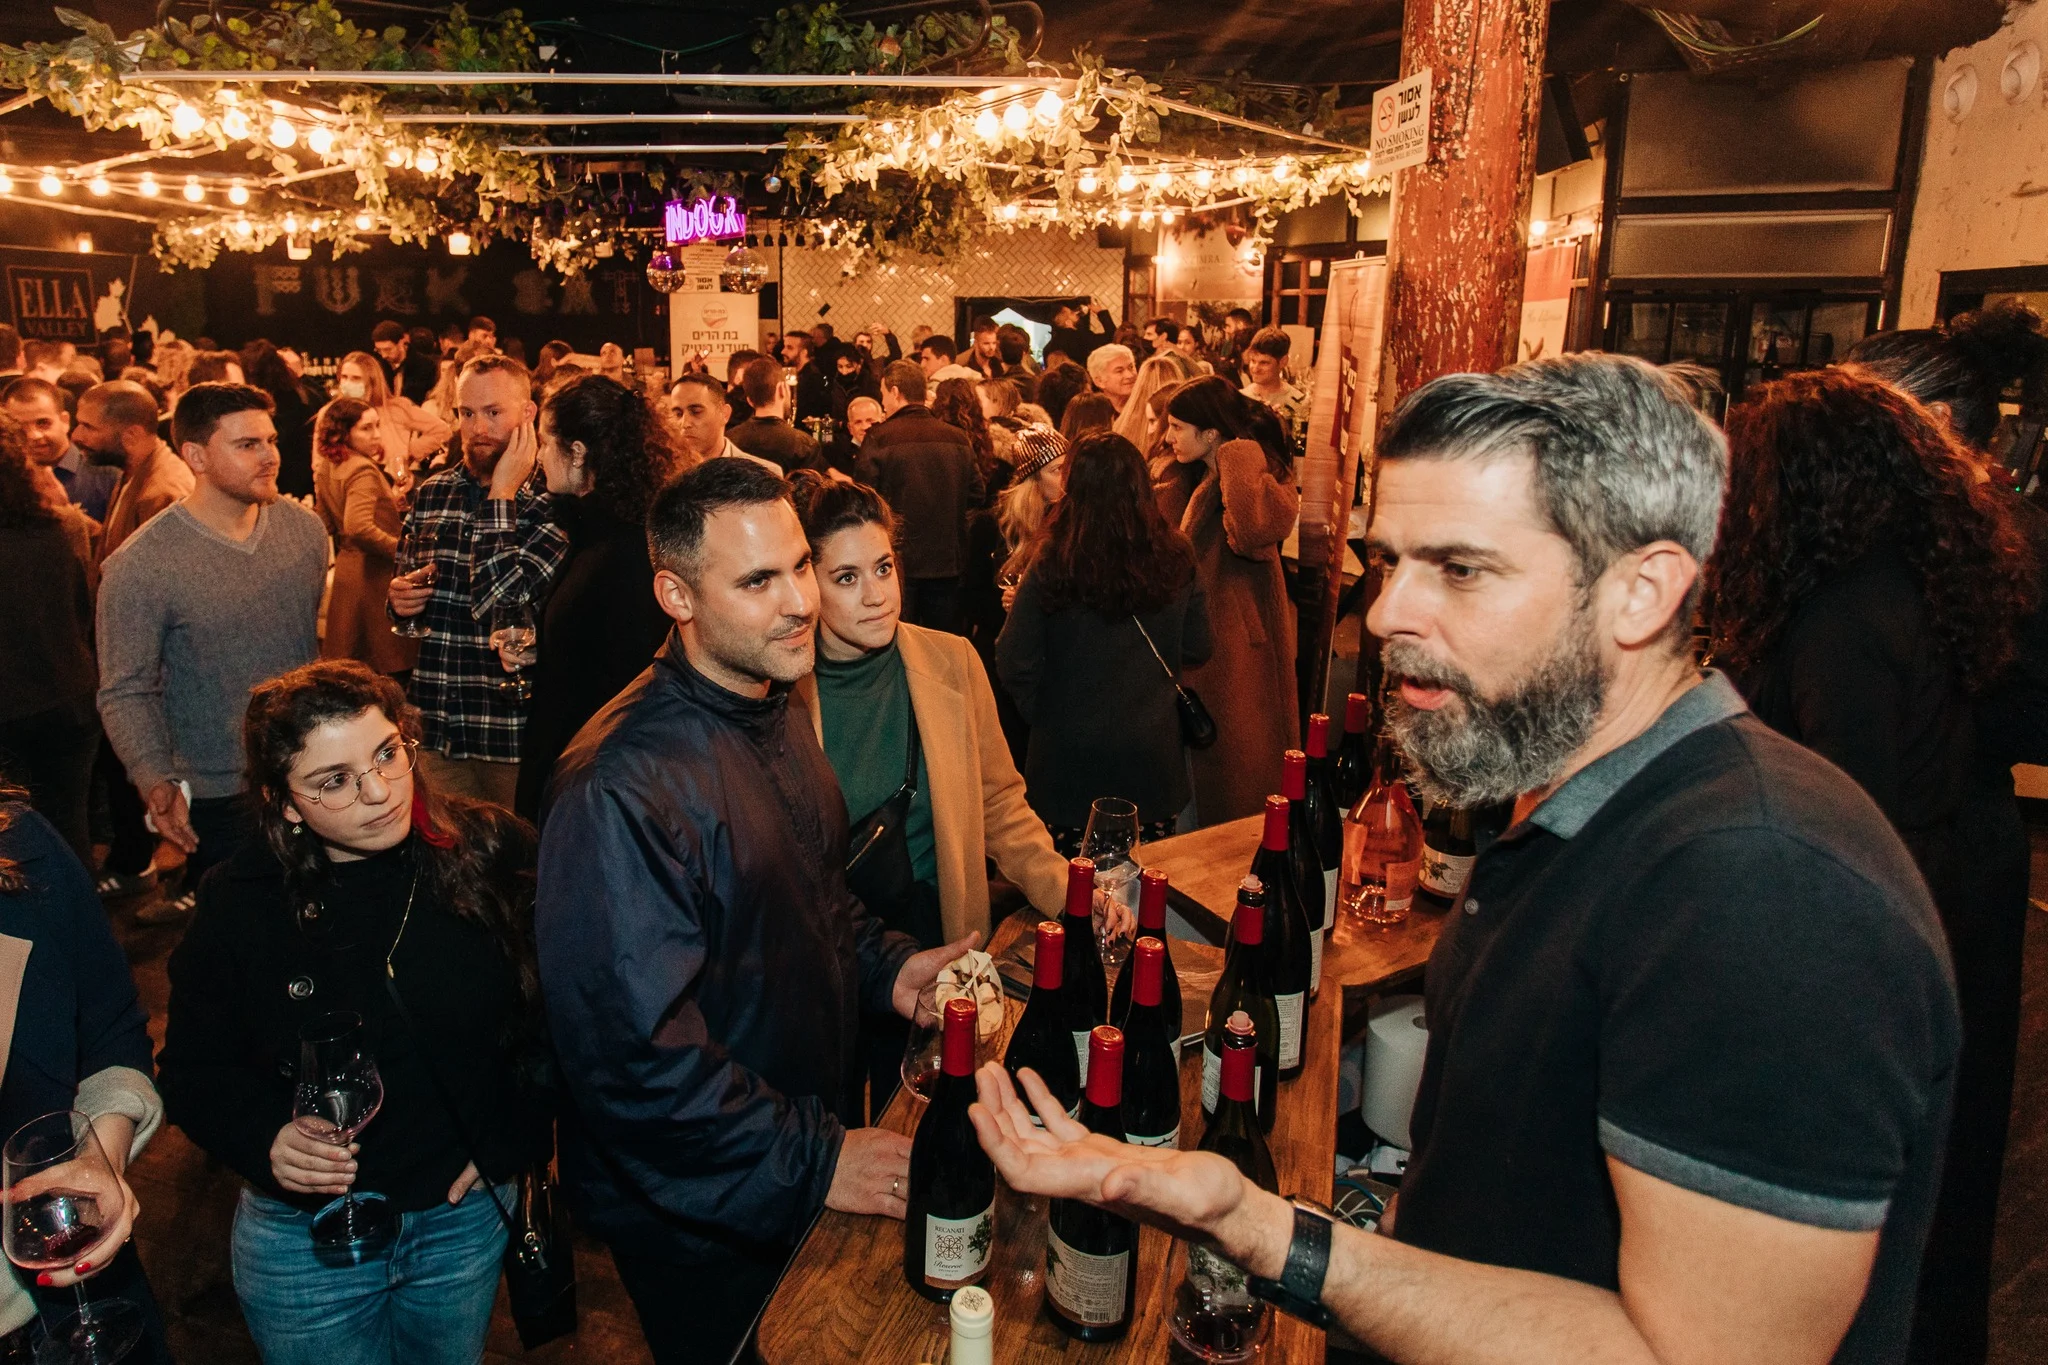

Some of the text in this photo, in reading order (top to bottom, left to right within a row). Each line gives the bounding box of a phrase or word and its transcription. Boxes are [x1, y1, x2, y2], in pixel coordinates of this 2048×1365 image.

[1398, 84, 1422, 106] אסור
[1397, 102, 1420, 128] לעשן
[1375, 124, 1424, 151] NO SMOKING
[17, 278, 88, 319] ELLA
[24, 320, 87, 336] VALLEY
[692, 330, 739, 341] בת הרים
[681, 343, 713, 357] בטיק
[934, 1225, 965, 1234] RECANATI
[933, 1260, 963, 1269] Reserve
